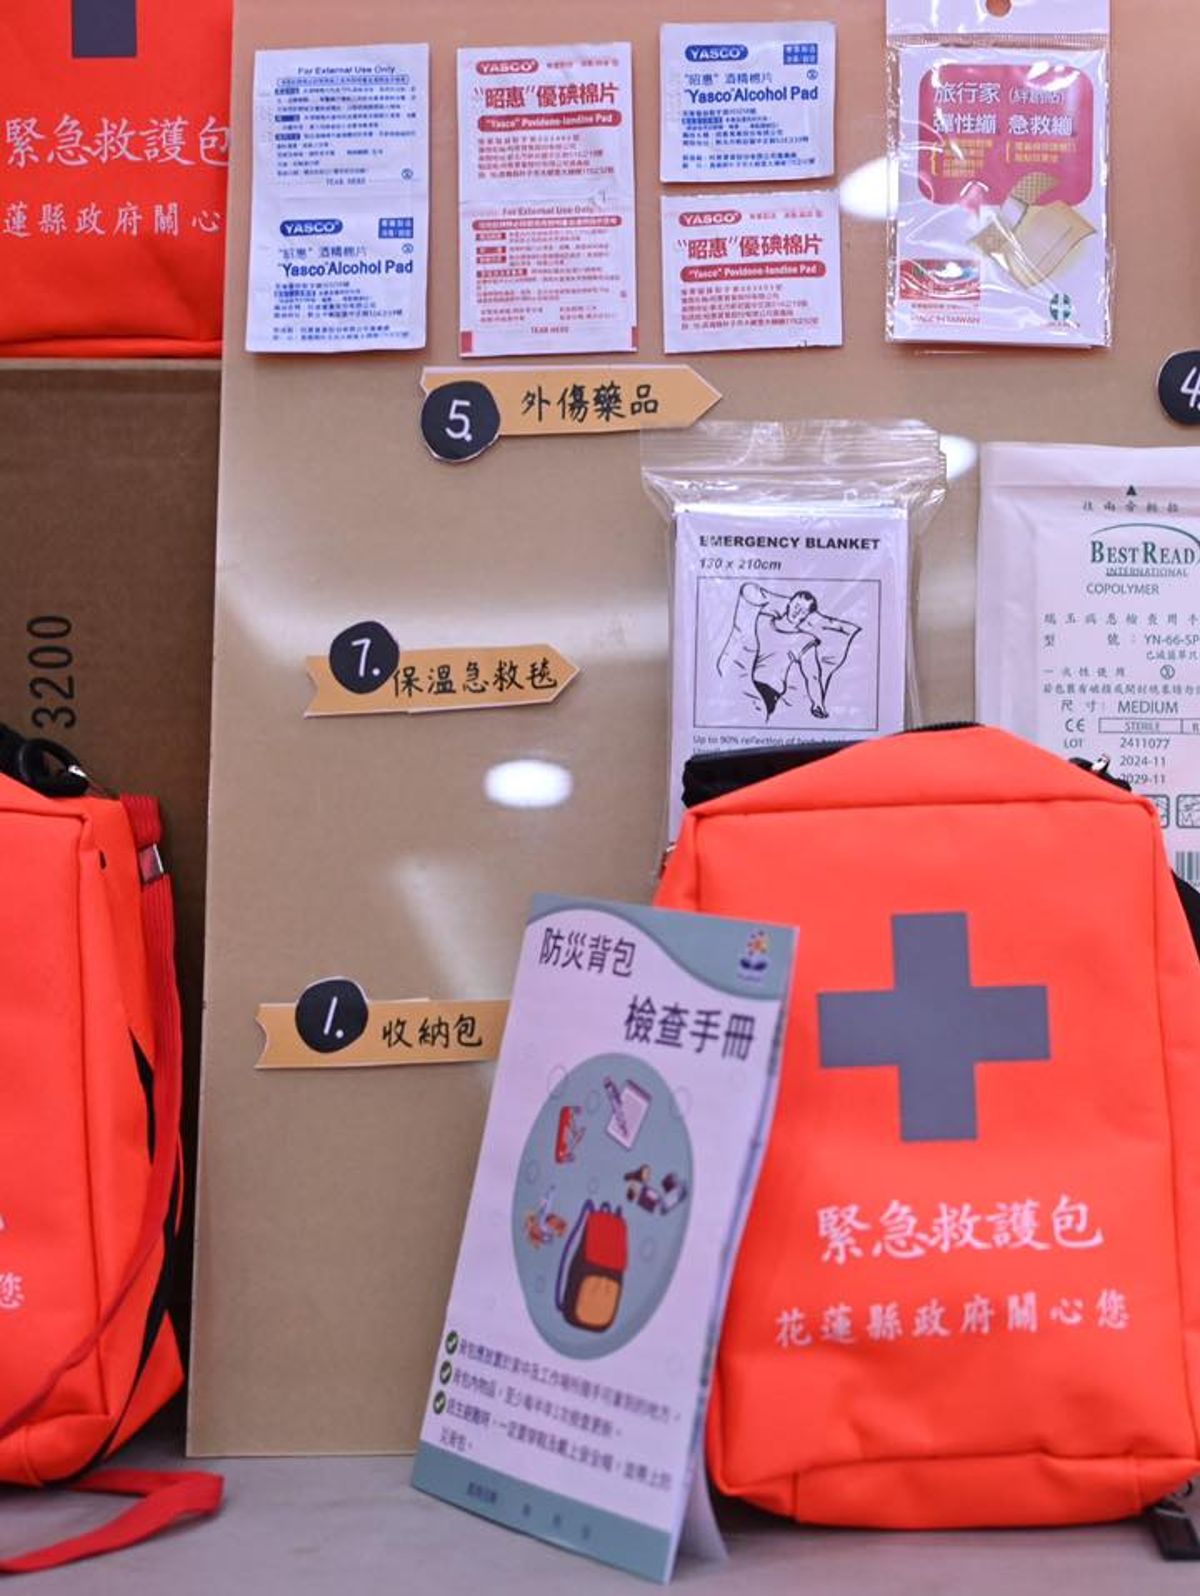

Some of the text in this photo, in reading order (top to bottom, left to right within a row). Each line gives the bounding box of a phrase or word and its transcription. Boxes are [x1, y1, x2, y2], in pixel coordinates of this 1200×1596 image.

[690, 46, 742, 60] YASCO
[480, 61, 537, 73] YASCO
[734, 86, 788, 102] Alcohol
[791, 86, 819, 100] Pad
[683, 212, 739, 225] YASCO
[284, 222, 336, 235] YASCO
[328, 259, 381, 275] Alcohol
[385, 260, 414, 274] Pad
[521, 384, 660, 423] 外傷藥品
[699, 534, 881, 551] EMERGENCY BLANKET
[737, 558, 782, 572] 210cm
[1086, 582, 1160, 595] COPOLYMER
[26, 615, 77, 729] 3200
[1117, 700, 1179, 715] MEDIUM
[1063, 737, 1170, 750] LOT 2411077
[1119, 755, 1167, 767] 2024-11
[538, 926, 637, 978] 防災背包
[380, 1013, 484, 1051] 收納包
[624, 995, 756, 1061] 檢查手冊
[816, 1195, 1105, 1266] 緊急救護包
[774, 1288, 1132, 1350] 花蓮縣政府關心您
